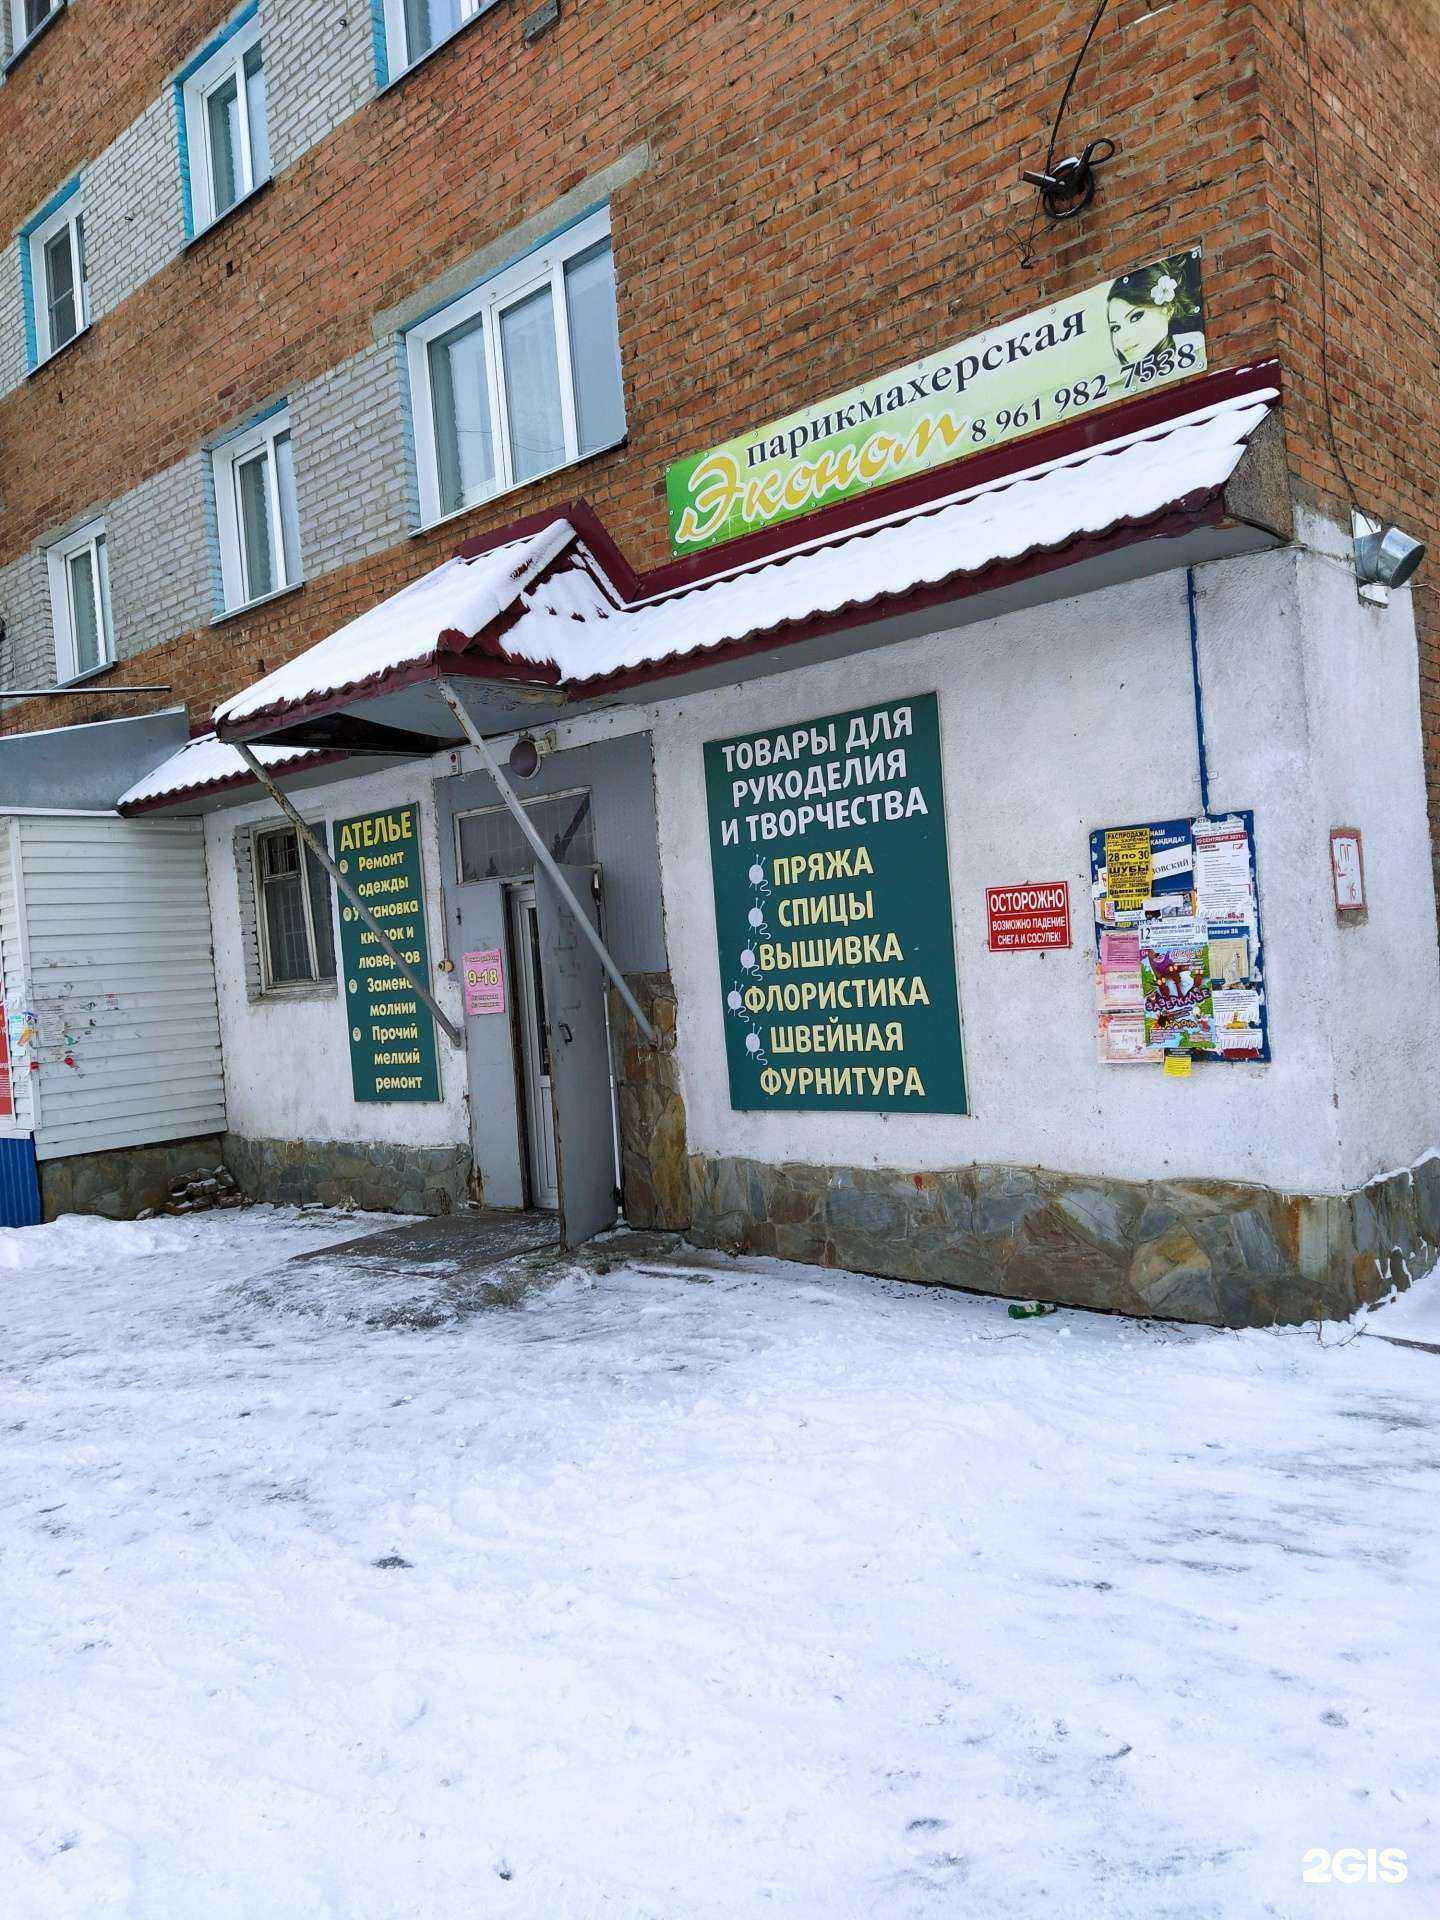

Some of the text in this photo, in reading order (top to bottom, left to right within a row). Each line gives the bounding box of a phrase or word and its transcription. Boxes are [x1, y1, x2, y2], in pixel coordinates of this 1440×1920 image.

[745, 307, 1087, 468] парикмахерская
[971, 342, 1197, 443] 8 961 982 7538
[676, 409, 968, 541] Эконом
[721, 705, 913, 773] ТОВАРЫ ДЛЯ
[731, 748, 907, 808] РУКОДЕЛИЯ
[721, 786, 929, 846] И ТВОРЧЕСТВА
[340, 811, 412, 852] АТЕЛЬЕ
[1151, 836, 1186, 846] КАНДИДАТ
[358, 851, 404, 871] Ремонт
[773, 846, 874, 886] ПРЯЖА
[1108, 852, 1120, 862] 28
[1138, 850, 1150, 860] 30
[1109, 864, 1149, 875] ШУБЫ
[358, 876, 409, 897] одежды
[777, 890, 874, 927] СПИЦЫ
[990, 888, 1065, 912] ОСТОРОЖНО
[406, 926, 414, 938] и
[992, 916, 1066, 931] ВОЗМОЖНО ПАДЕНИЕ
[997, 932, 1061, 945] СНЕГА И СОСУЛЕК!
[759, 932, 904, 971] ВЫШИВКА
[468, 968, 499, 987] 9-18
[744, 976, 930, 1013] ФЛОРИСТИКА
[1145, 988, 1211, 1012] ЗАЗЕРКАЛЬЕ
[370, 1002, 417, 1017] молнии
[372, 1023, 418, 1044] Прочий
[770, 1016, 904, 1053] ШВЕЙНАЯ
[374, 1048, 421, 1065] мелкий
[375, 1076, 422, 1093] ремонт
[760, 1066, 925, 1096] ФУРНИТУРА
